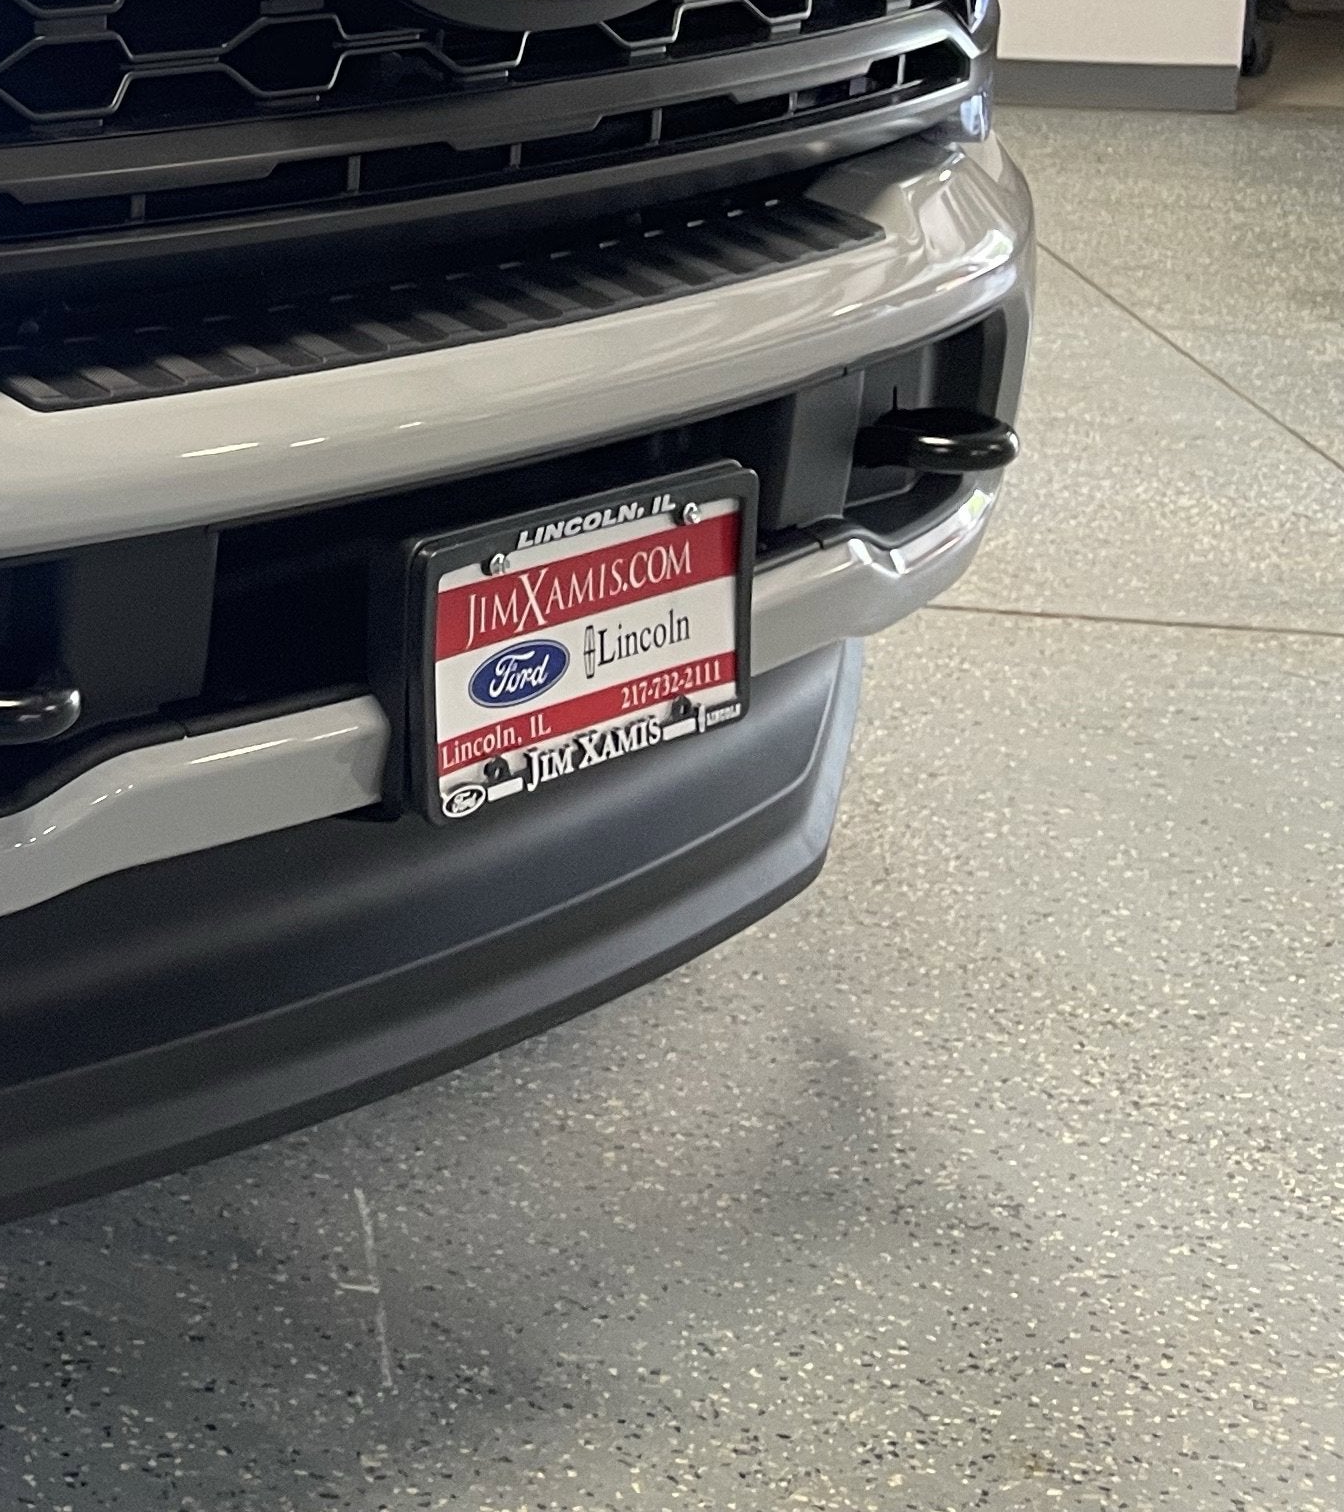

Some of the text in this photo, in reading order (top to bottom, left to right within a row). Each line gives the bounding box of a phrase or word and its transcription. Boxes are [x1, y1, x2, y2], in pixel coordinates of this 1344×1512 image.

[516, 493, 677, 551] LINCOLN, IL
[465, 539, 692, 649] JIMXAMIS.COM
[597, 608, 690, 667] Lincoln
[488, 650, 550, 698] Ford
[620, 659, 721, 710] 217-732-2111
[526, 717, 662, 792] JIM XAMIS
[530, 713, 552, 739] IL
